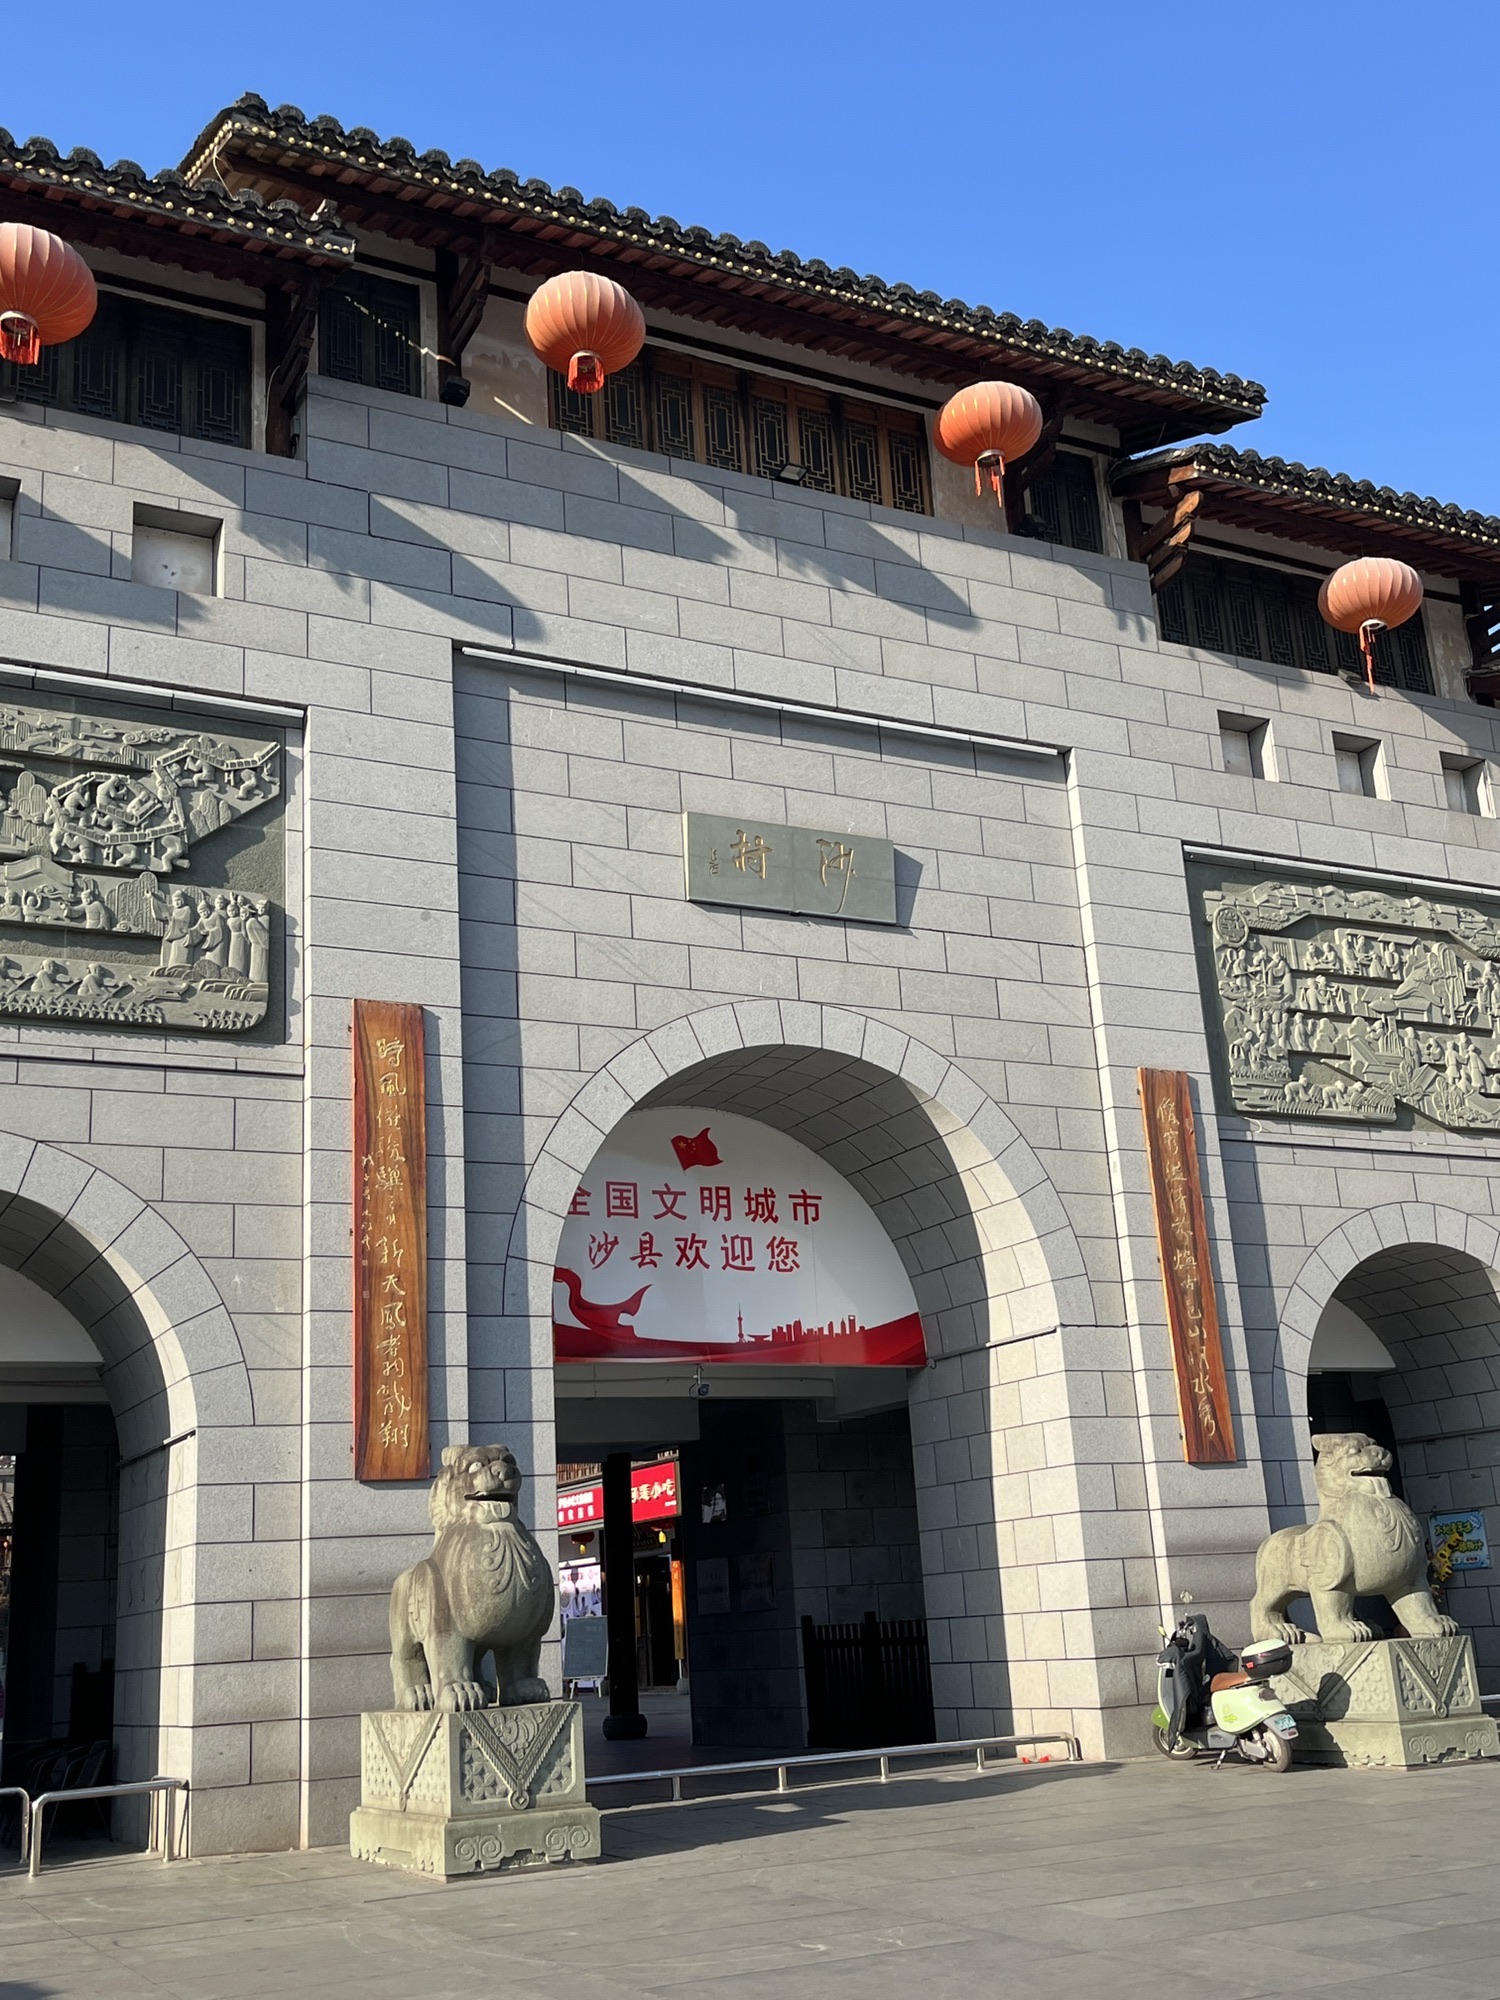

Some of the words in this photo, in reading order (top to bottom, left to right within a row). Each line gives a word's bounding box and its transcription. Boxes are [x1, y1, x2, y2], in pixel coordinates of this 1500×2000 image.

[568, 1181, 823, 1225] 全国文明城市
[588, 1230, 801, 1273] 沙县欢迎您
